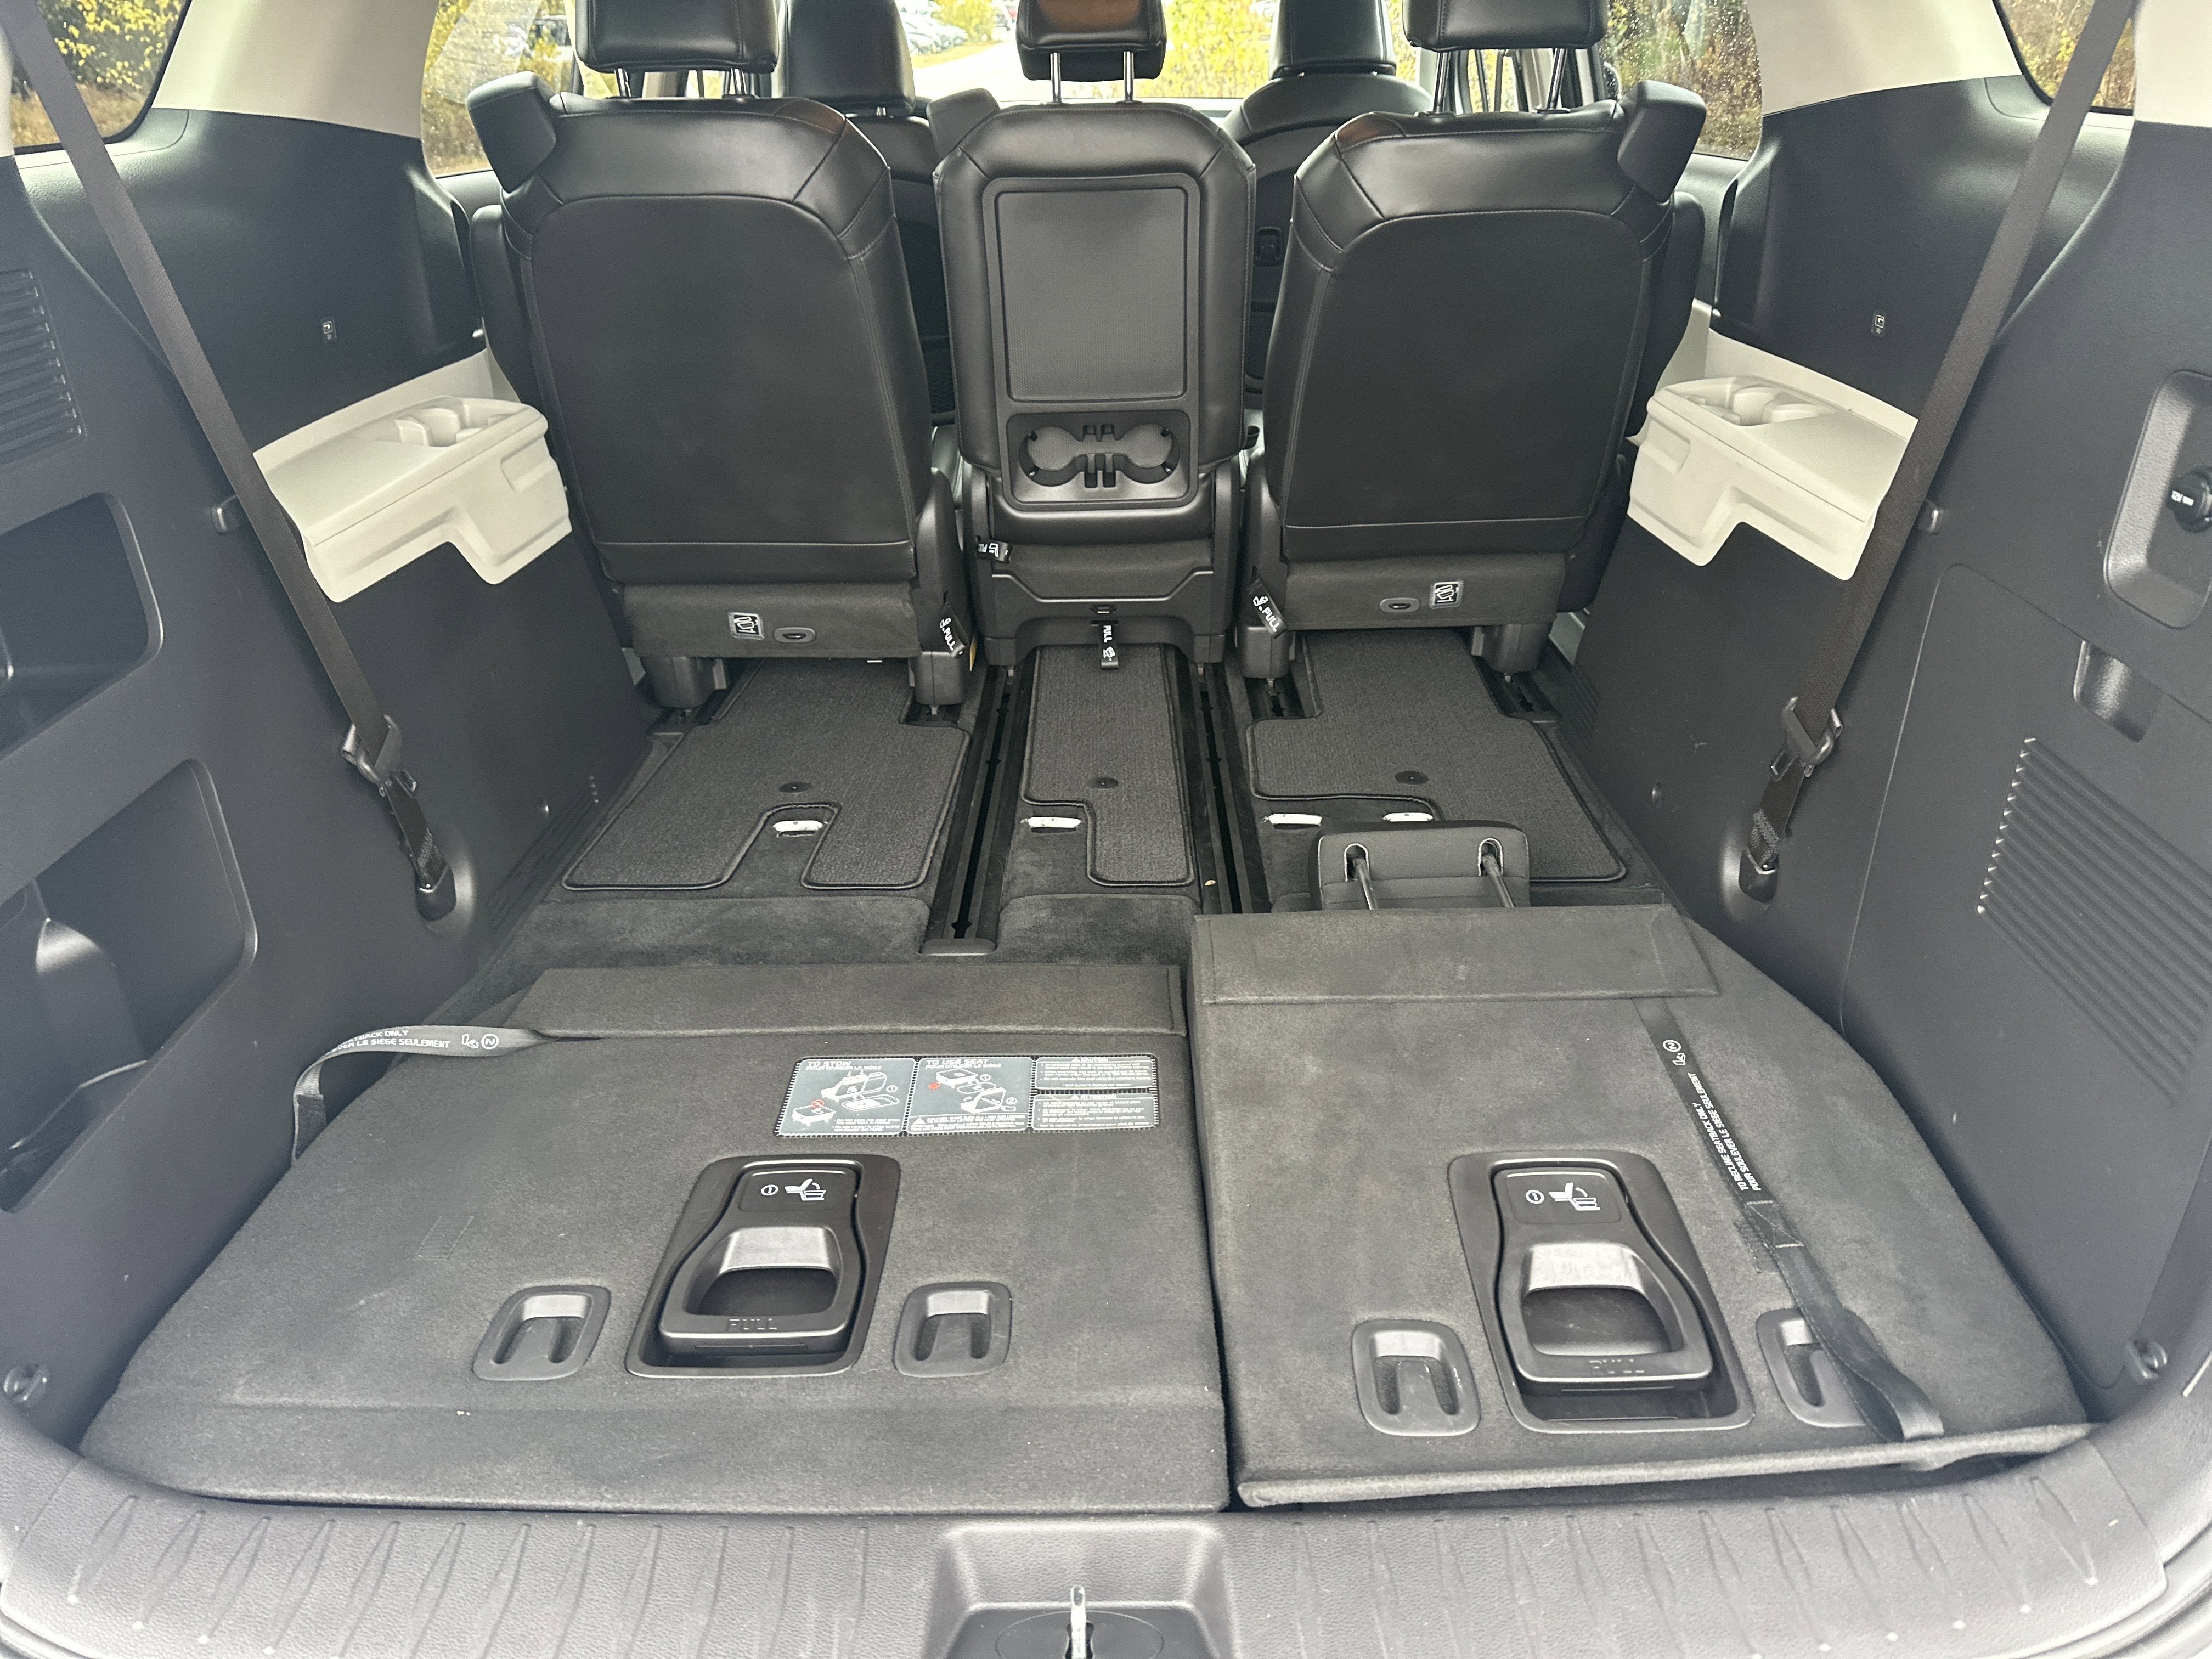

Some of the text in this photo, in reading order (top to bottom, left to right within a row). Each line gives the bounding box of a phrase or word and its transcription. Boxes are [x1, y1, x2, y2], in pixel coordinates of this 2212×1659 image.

[1261, 606, 1280, 633] PULL
[943, 627, 956, 651] PULL
[1103, 625, 1113, 643] PULL
[399, 1037, 451, 1048] SEULEMENT
[1688, 1073, 1714, 1109] SEULEMENT
[1718, 1128, 1730, 1138] LE
[1692, 1102, 1750, 1192] TO RECLINE SEATBACK ONLY
[1724, 1138, 1750, 1172] SOULEVER
[1743, 1172, 1762, 1190] POUR
[726, 1318, 778, 1331] PULL
